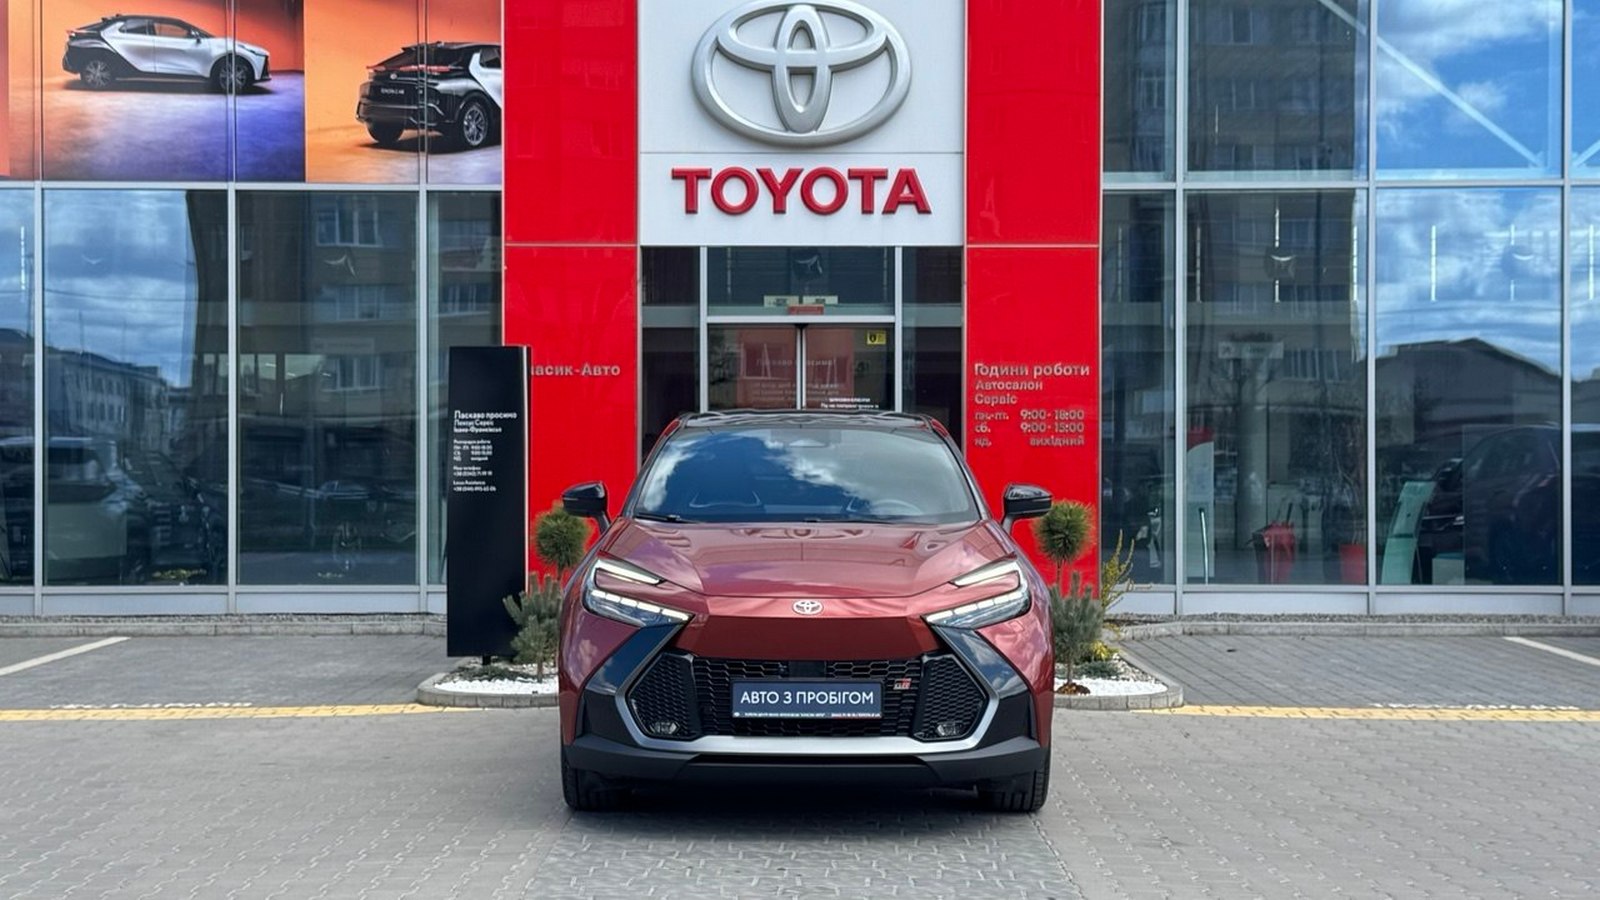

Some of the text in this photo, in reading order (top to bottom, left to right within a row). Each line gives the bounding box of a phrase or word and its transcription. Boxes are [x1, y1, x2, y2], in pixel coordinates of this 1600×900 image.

[671, 166, 932, 215] TOYOTA
[974, 362, 1090, 379] Години роботи
[975, 380, 1043, 391] Автосалон
[974, 393, 1018, 407] Сервіс
[740, 691, 780, 705] АВТО
[796, 691, 875, 705] ПРОБІГОМ
